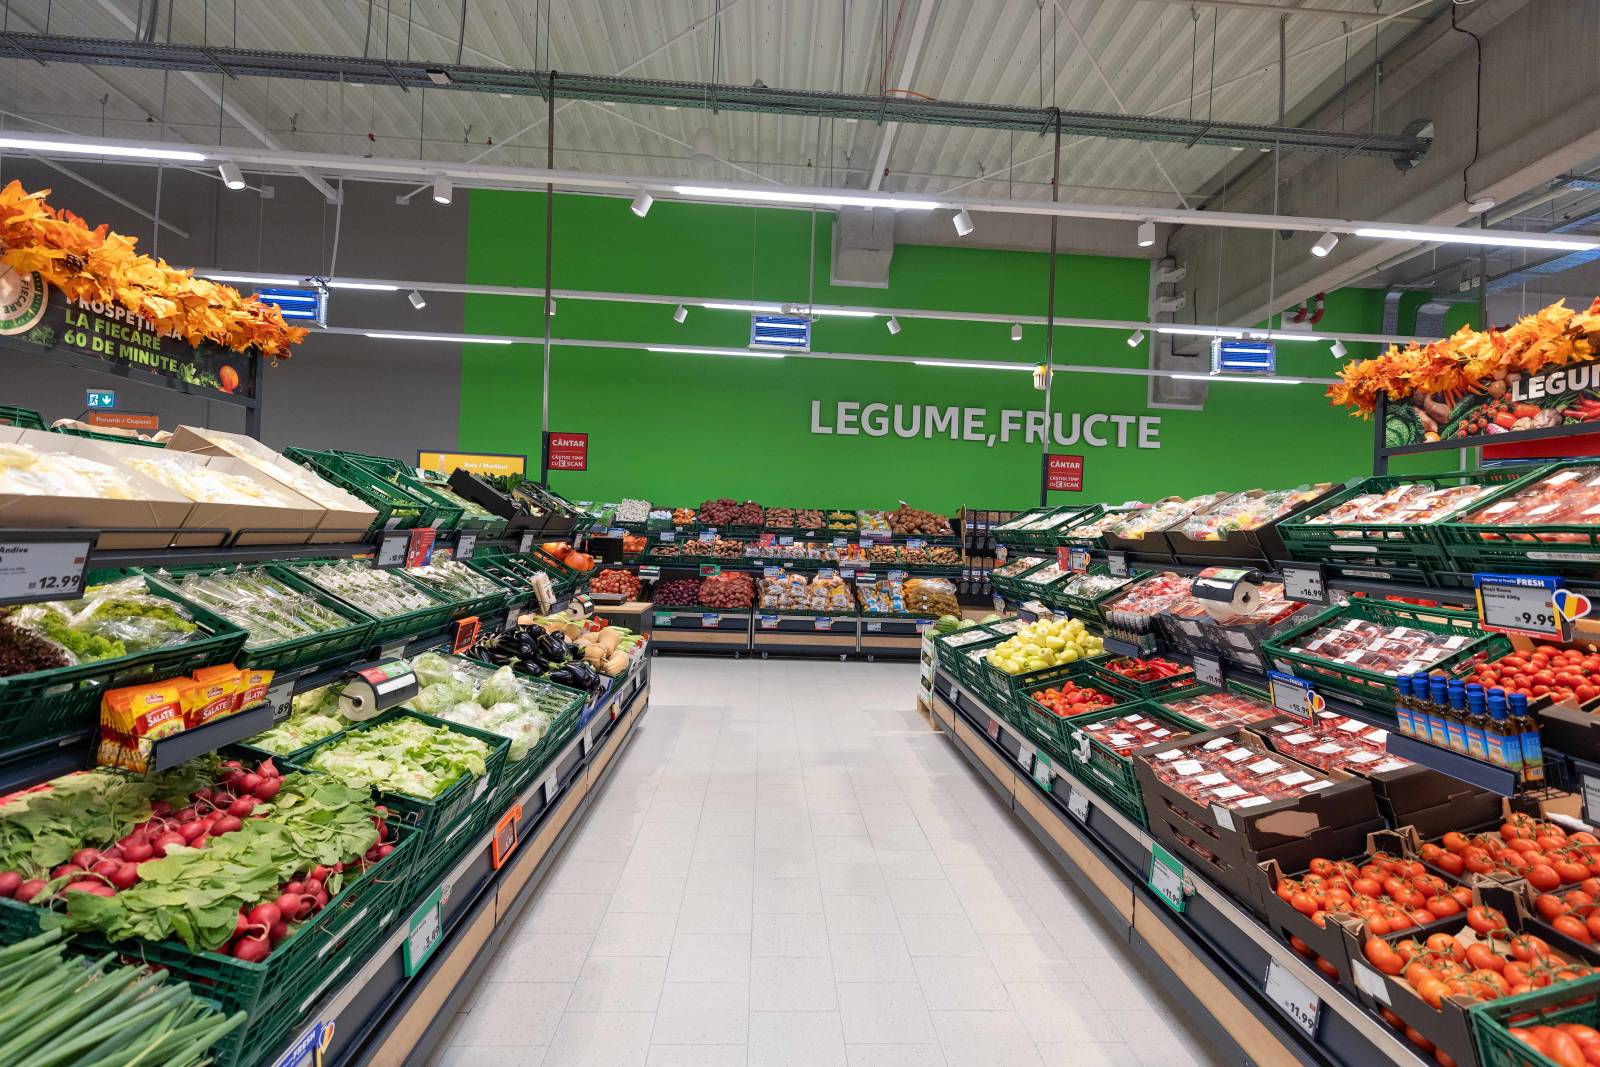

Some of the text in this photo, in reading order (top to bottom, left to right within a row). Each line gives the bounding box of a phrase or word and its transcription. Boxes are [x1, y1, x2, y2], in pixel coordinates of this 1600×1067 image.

[65, 309, 161, 351] LA FIECARE
[64, 329, 178, 372] 60 DE MINUTE
[552, 438, 585, 447] CÂNTAR
[1050, 461, 1080, 469] CÂNTAR
[39, 575, 81, 590] 12.99
[1516, 578, 1545, 587] FRESH
[1304, 589, 1322, 597] 16.99
[1522, 612, 1555, 626] 9.99
[202, 700, 228, 720] SALATE
[147, 709, 175, 728] SALATE
[1290, 1003, 1314, 1029] 11.99
